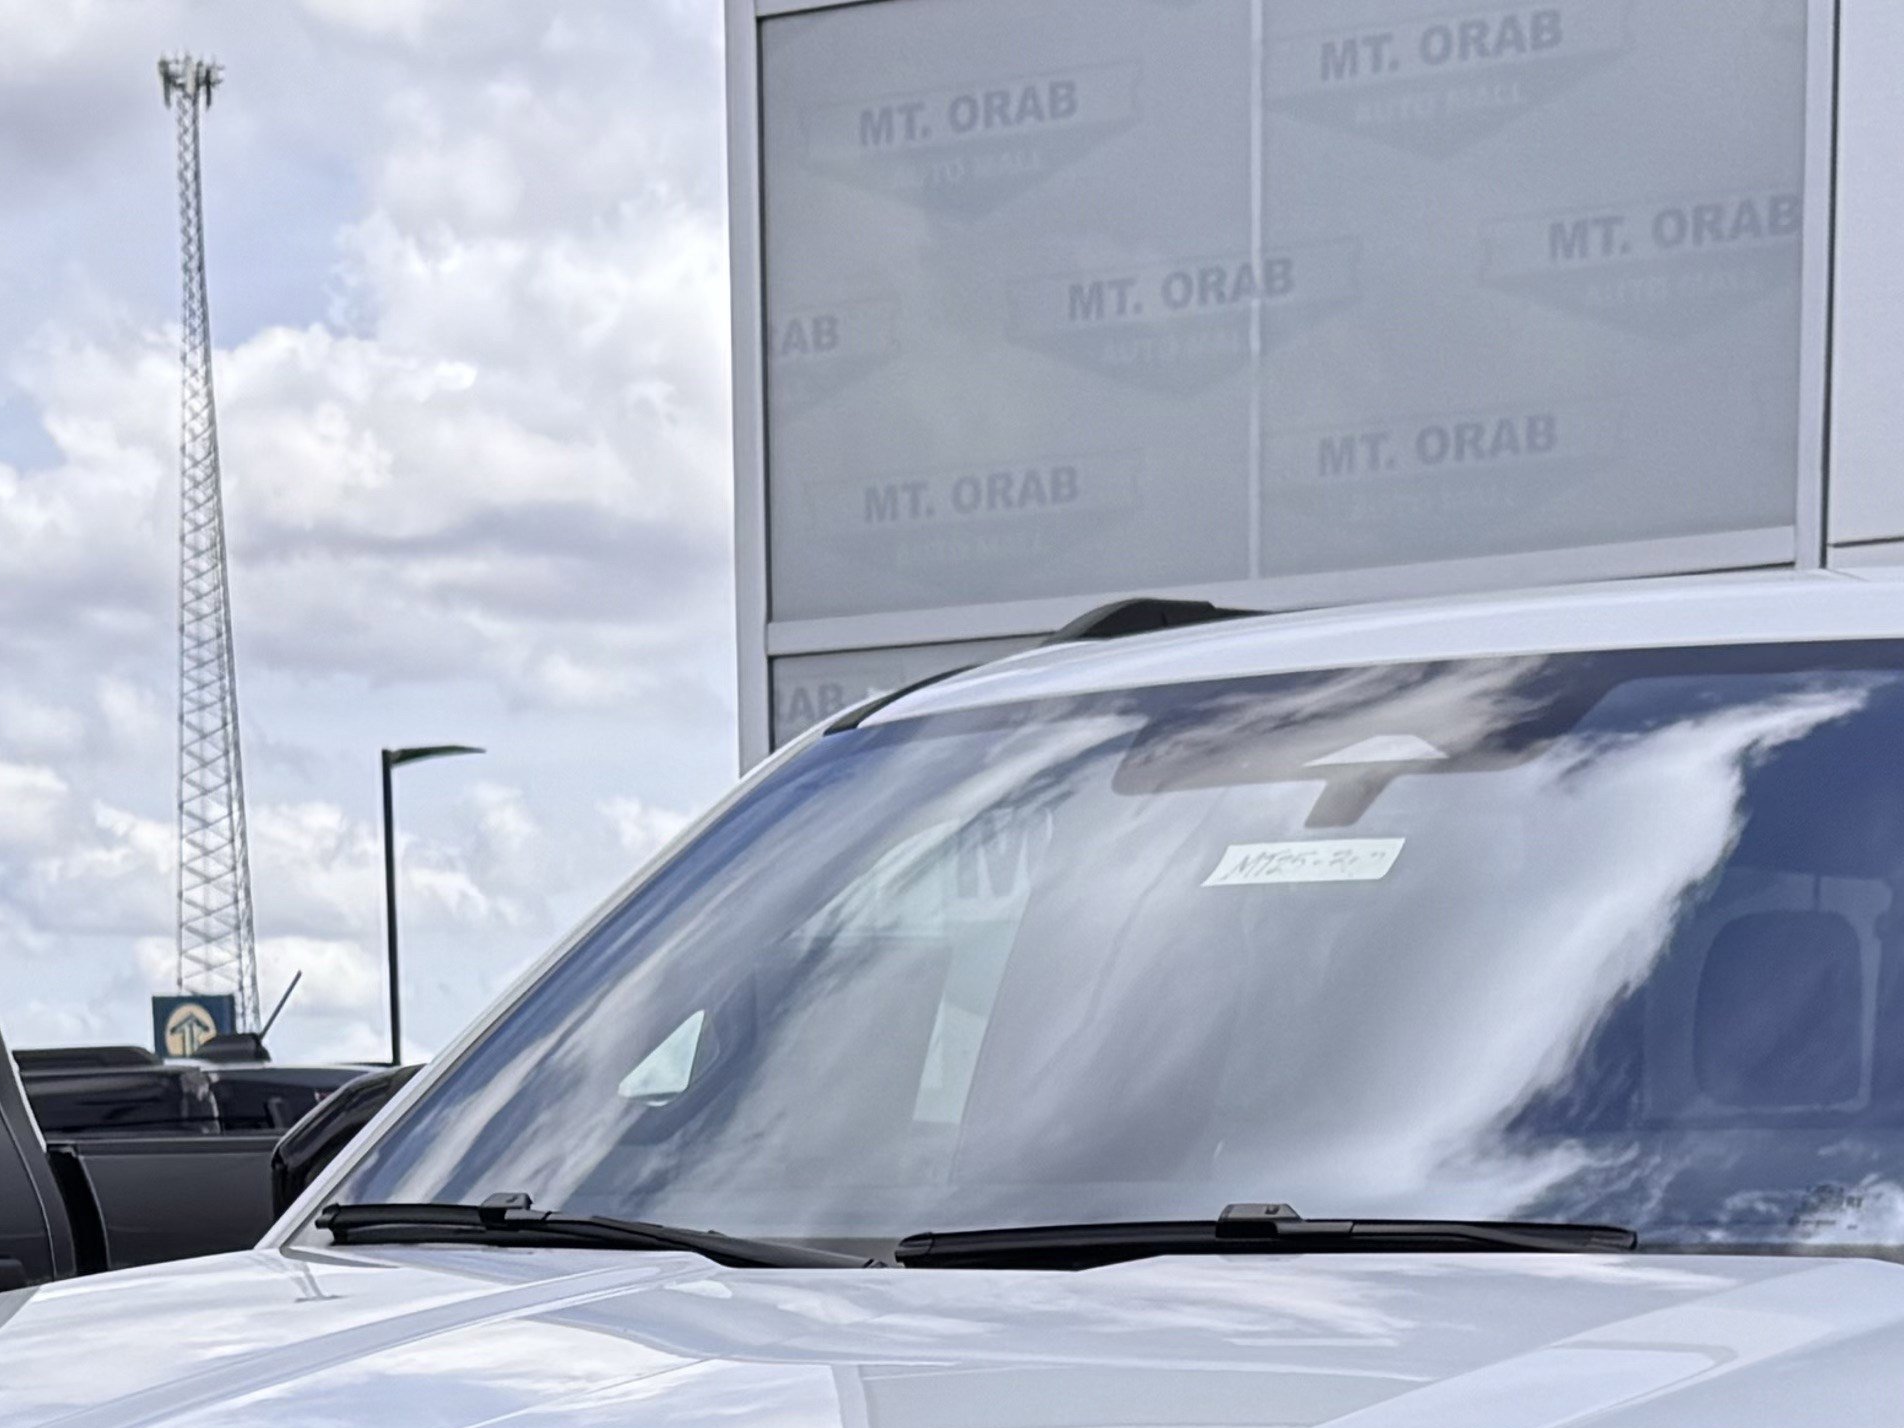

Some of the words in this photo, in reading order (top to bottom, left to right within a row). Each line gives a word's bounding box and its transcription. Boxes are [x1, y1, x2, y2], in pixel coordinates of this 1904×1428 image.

[1319, 32, 1400, 83] MT.
[1418, 8, 1564, 66] ORAB
[859, 101, 931, 147] MT.
[946, 78, 1079, 135] ORAB
[1547, 212, 1633, 263] MT.
[1651, 191, 1804, 250] ORAB
[1067, 277, 1144, 322] MT.
[1160, 256, 1295, 311] ORAB
[770, 314, 840, 357] AB
[1317, 429, 1397, 478] MT.
[1414, 411, 1559, 467] ORAB
[863, 481, 936, 525] MT.
[950, 464, 1081, 514] ORAB
[775, 682, 844, 722] AB
